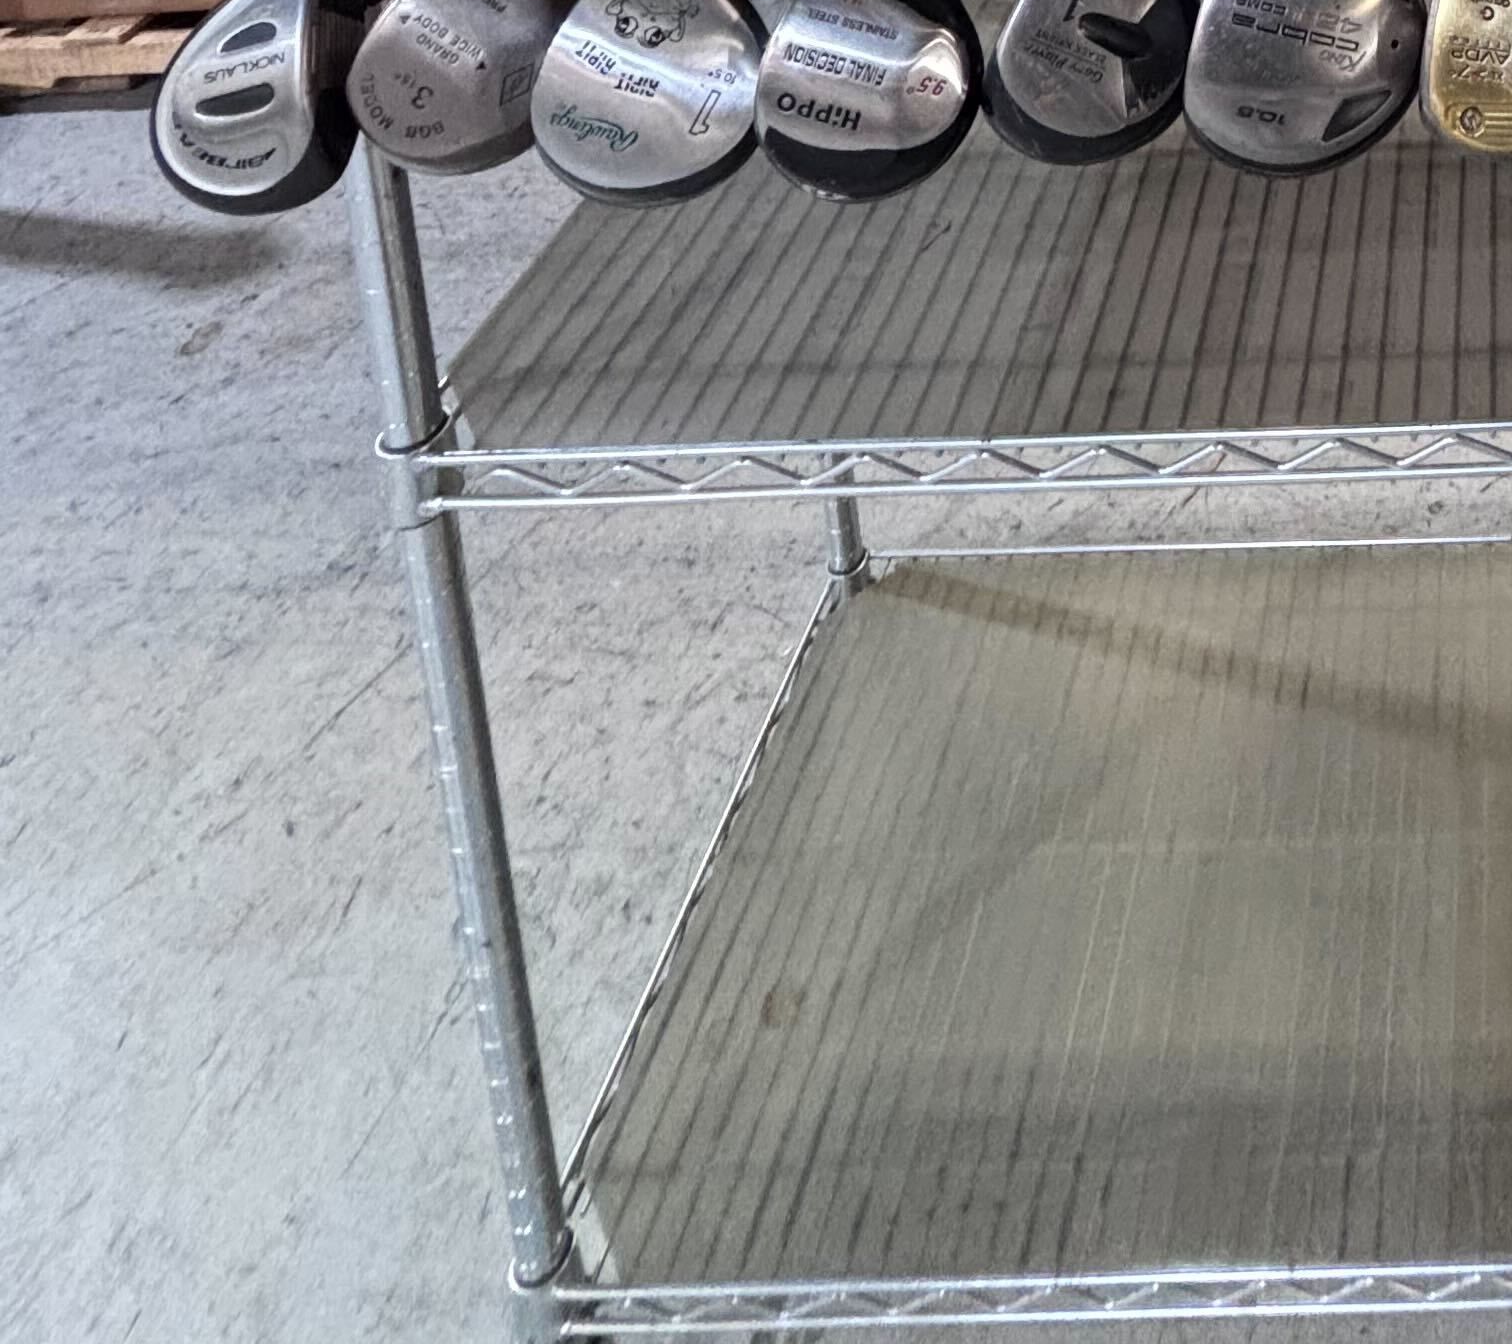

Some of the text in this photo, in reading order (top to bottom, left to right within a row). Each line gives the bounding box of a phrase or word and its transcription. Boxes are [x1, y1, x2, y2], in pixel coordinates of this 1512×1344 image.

[413, 12, 449, 39] BODY
[806, 7, 899, 42] STAINLESS STEEL
[1232, 13, 1359, 52] cobra
[416, 33, 460, 65] GRAND
[784, 42, 887, 87] FINAL DECISION
[204, 52, 285, 84] NICKLAUS
[411, 85, 434, 110] 3
[906, 76, 948, 97] 9.5°
[550, 104, 640, 152] Rawlings
[688, 89, 722, 136] 1
